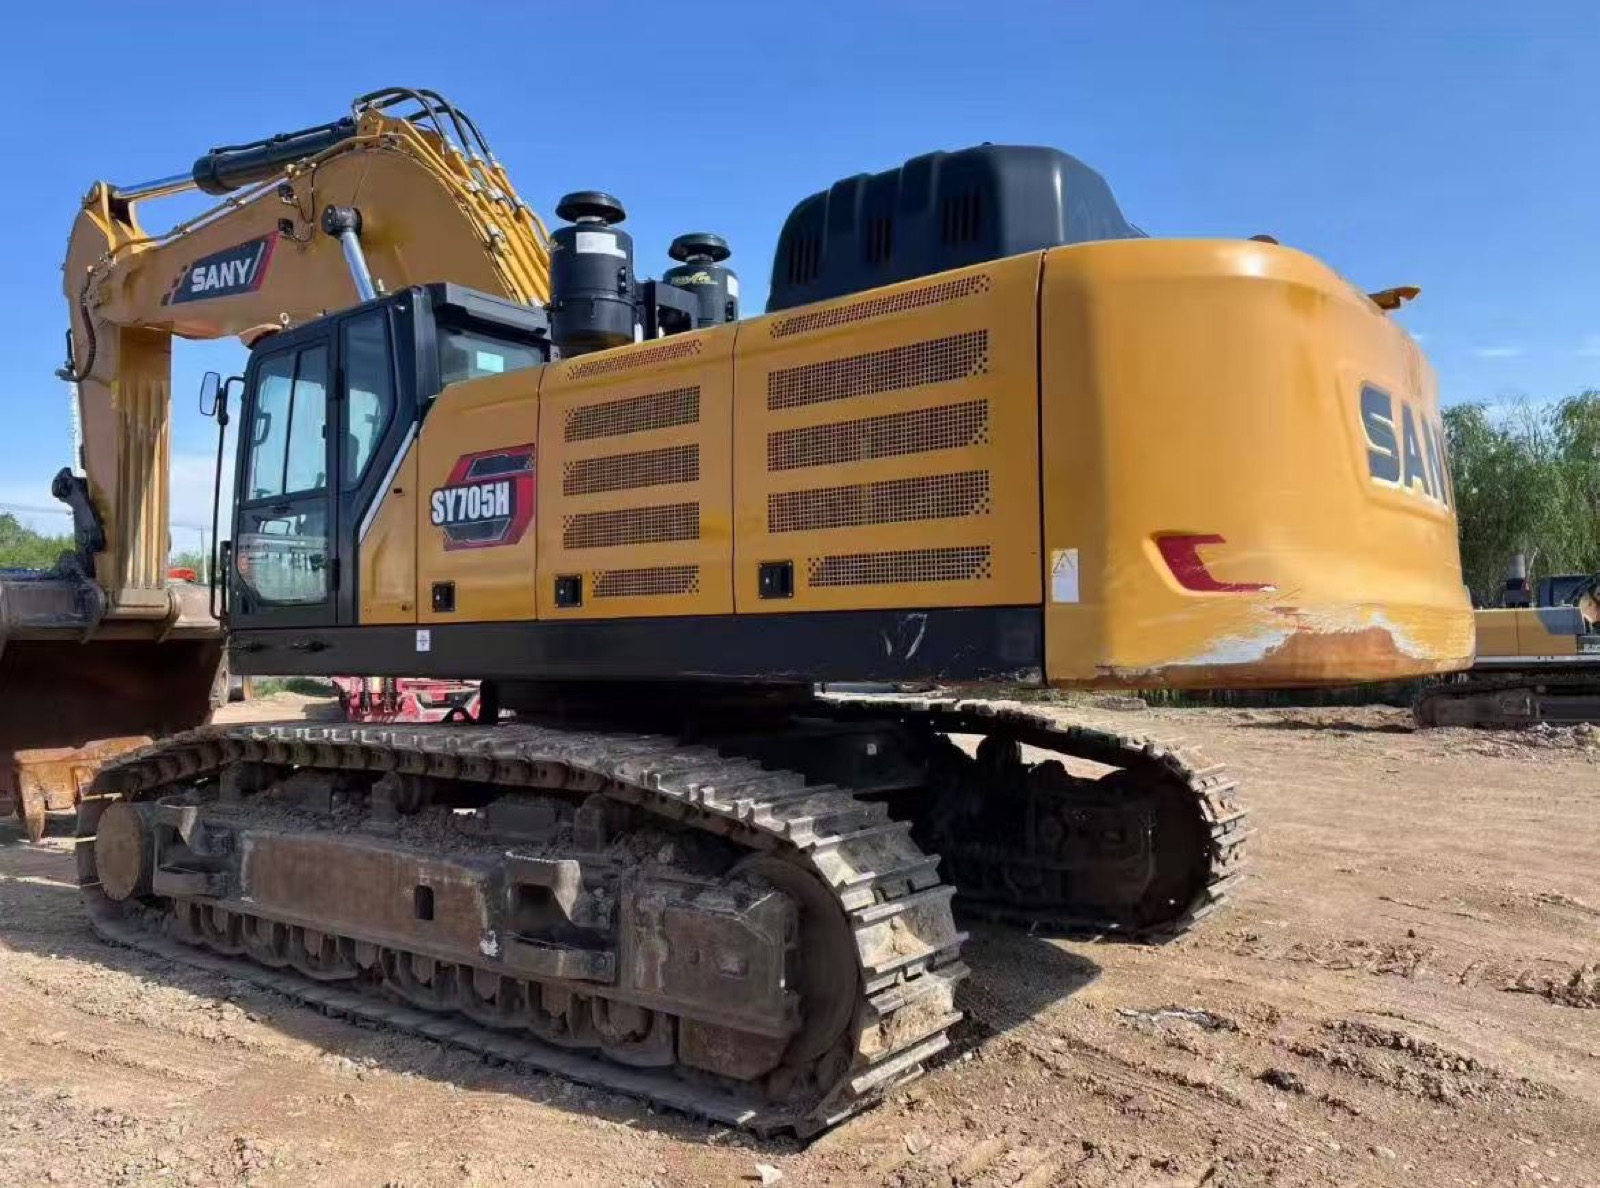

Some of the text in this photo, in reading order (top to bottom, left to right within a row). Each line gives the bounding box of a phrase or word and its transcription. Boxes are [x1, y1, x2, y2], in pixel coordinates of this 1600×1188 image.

[191, 258, 253, 293] SANY
[1360, 385, 1450, 507] SAN
[431, 480, 510, 524] SY705H
